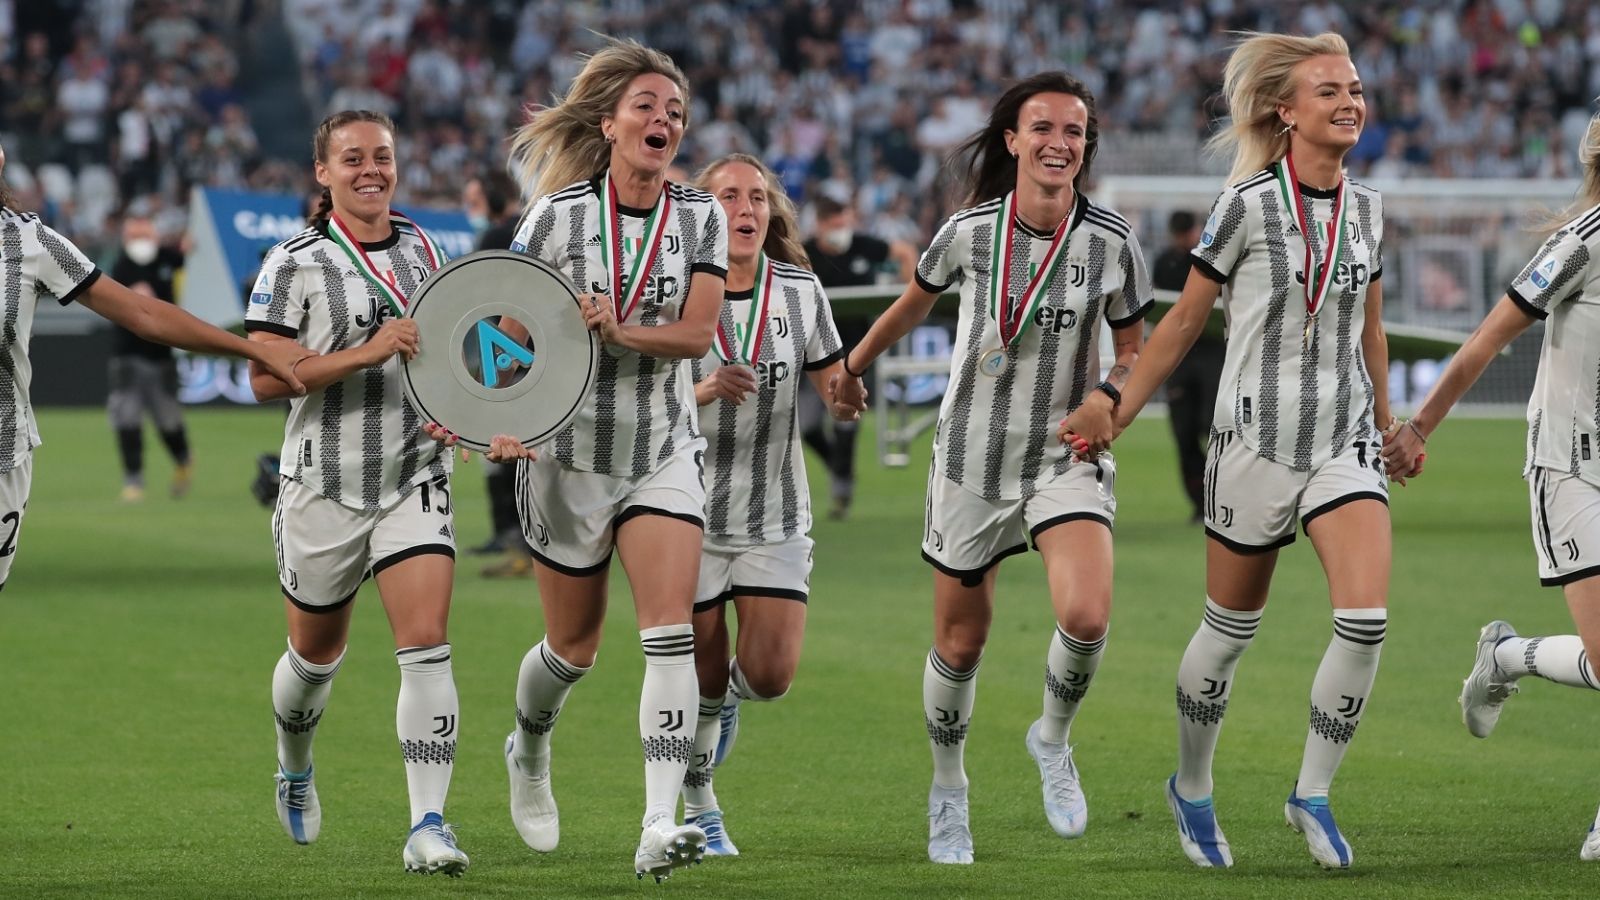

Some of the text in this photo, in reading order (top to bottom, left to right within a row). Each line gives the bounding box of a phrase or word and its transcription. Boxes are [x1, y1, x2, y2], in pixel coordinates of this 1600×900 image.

[1295, 262, 1367, 291] ep
[355, 297, 396, 328] Je
[990, 297, 1078, 333] Jep
[414, 474, 450, 515] 13
